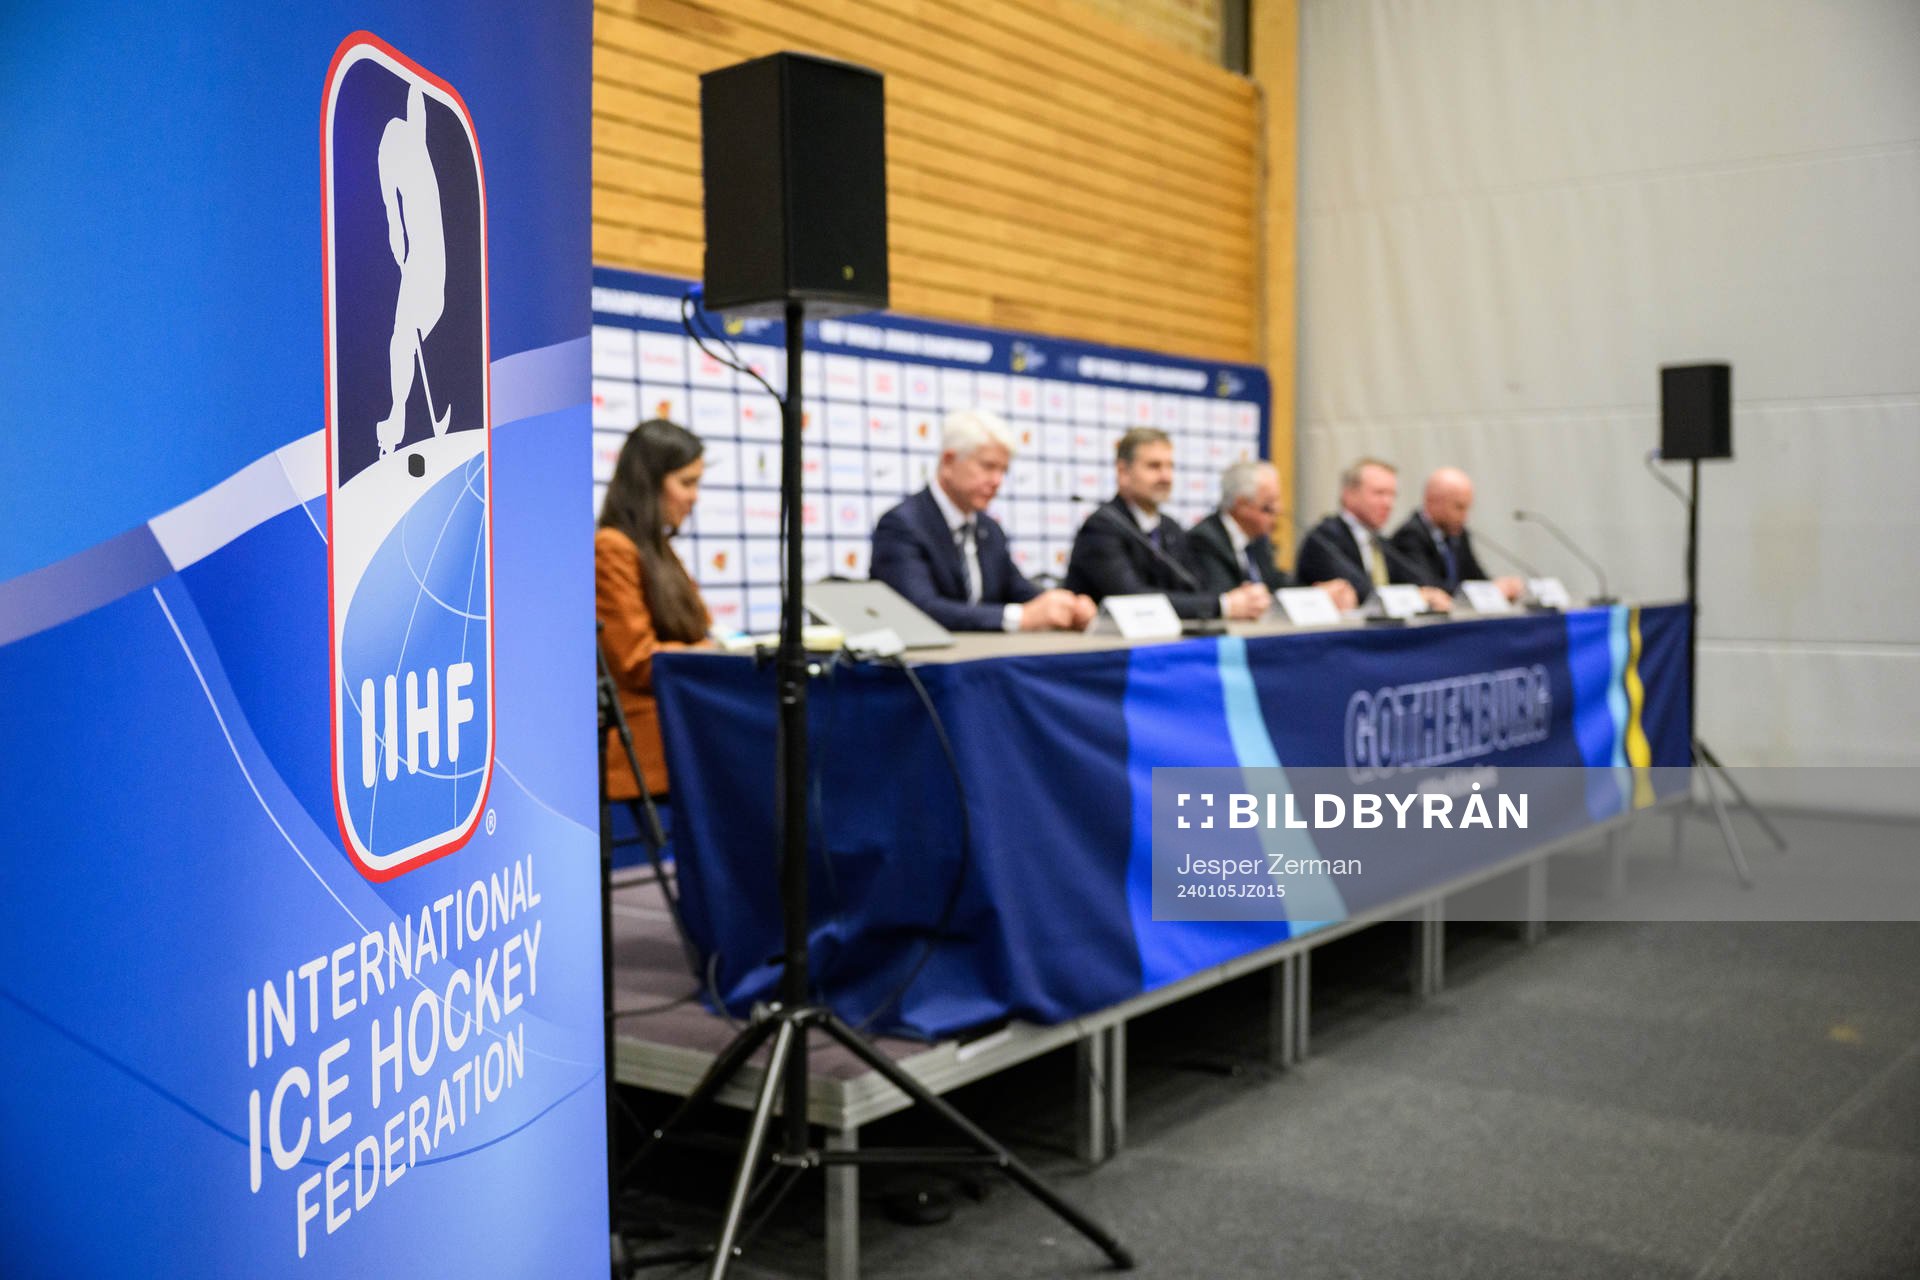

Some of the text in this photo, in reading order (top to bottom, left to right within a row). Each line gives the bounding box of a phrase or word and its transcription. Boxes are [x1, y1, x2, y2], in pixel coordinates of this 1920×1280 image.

[361, 662, 474, 789] IIHF
[247, 854, 542, 1068] INTERNATIONAL
[249, 920, 543, 1194] ICE HOCKEY
[297, 1023, 525, 1259] FEDERATION
